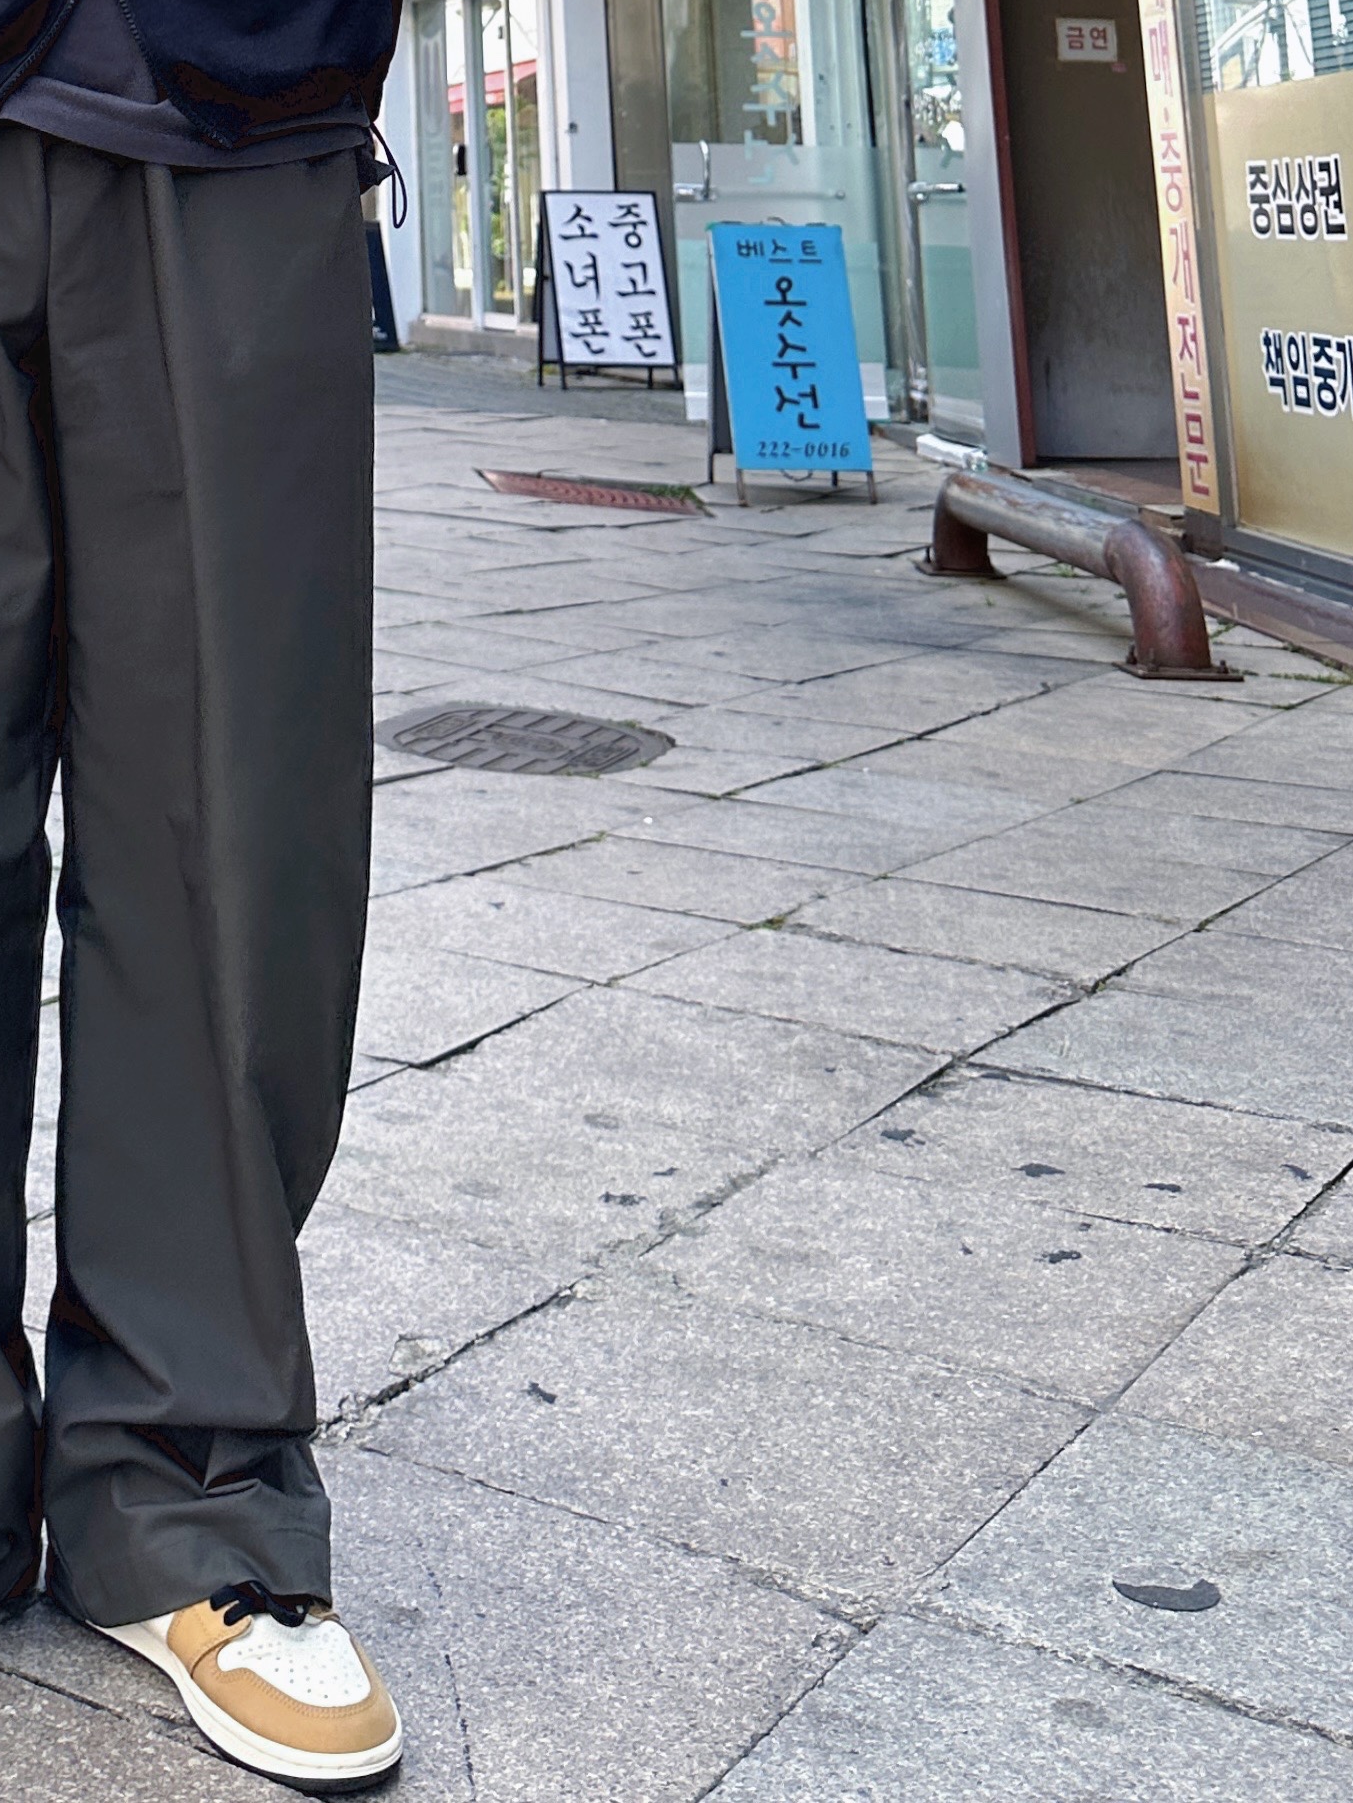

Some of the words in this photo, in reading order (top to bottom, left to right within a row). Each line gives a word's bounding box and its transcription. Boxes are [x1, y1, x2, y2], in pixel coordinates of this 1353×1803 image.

[1065, 26, 1108, 51] 금연
[1247, 154, 1347, 237] 중심상권
[558, 203, 610, 356] 소녀폰
[608, 203, 662, 358] 중고폰
[736, 238, 823, 264] 베스트
[763, 275, 821, 430] 옷수선
[757, 440, 851, 458] 222-0016
